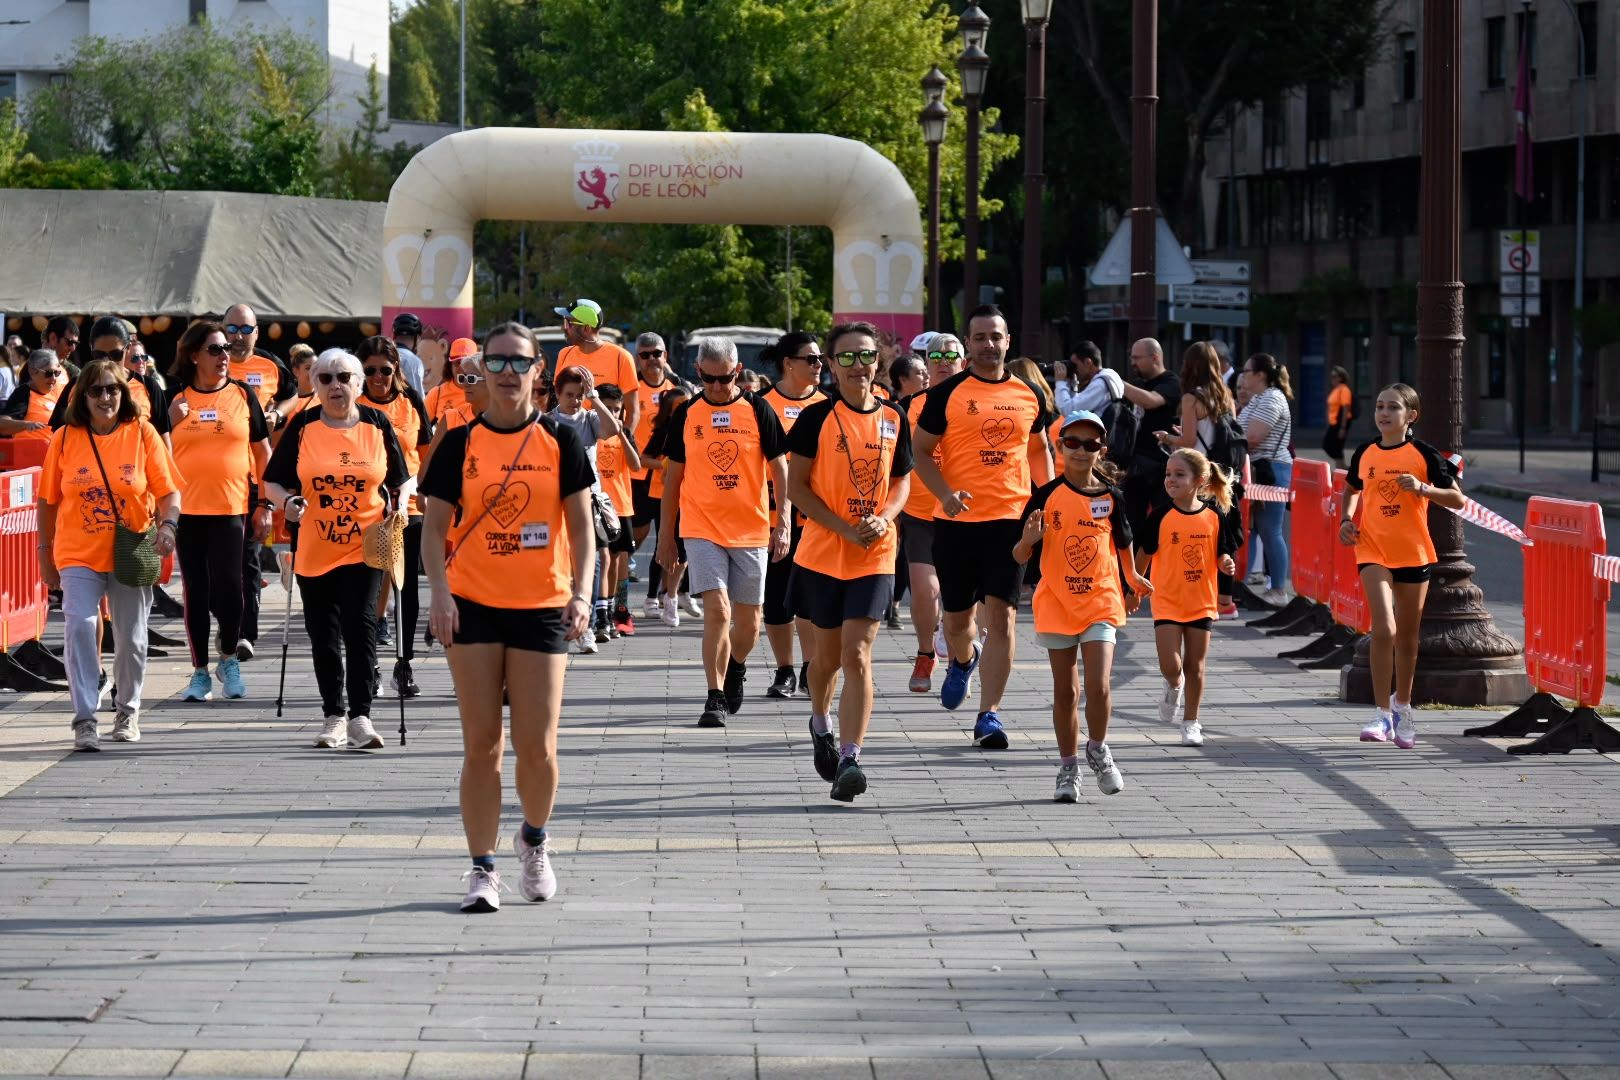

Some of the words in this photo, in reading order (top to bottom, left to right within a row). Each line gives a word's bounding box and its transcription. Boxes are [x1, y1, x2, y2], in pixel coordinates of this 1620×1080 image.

[627, 161, 743, 179] DIPUTACIÓN
[627, 182, 651, 198] DE
[656, 179, 707, 198] LEÓN
[485, 531, 508, 541] CORRE
[534, 532, 547, 541] 148
[488, 541, 499, 550] LA
